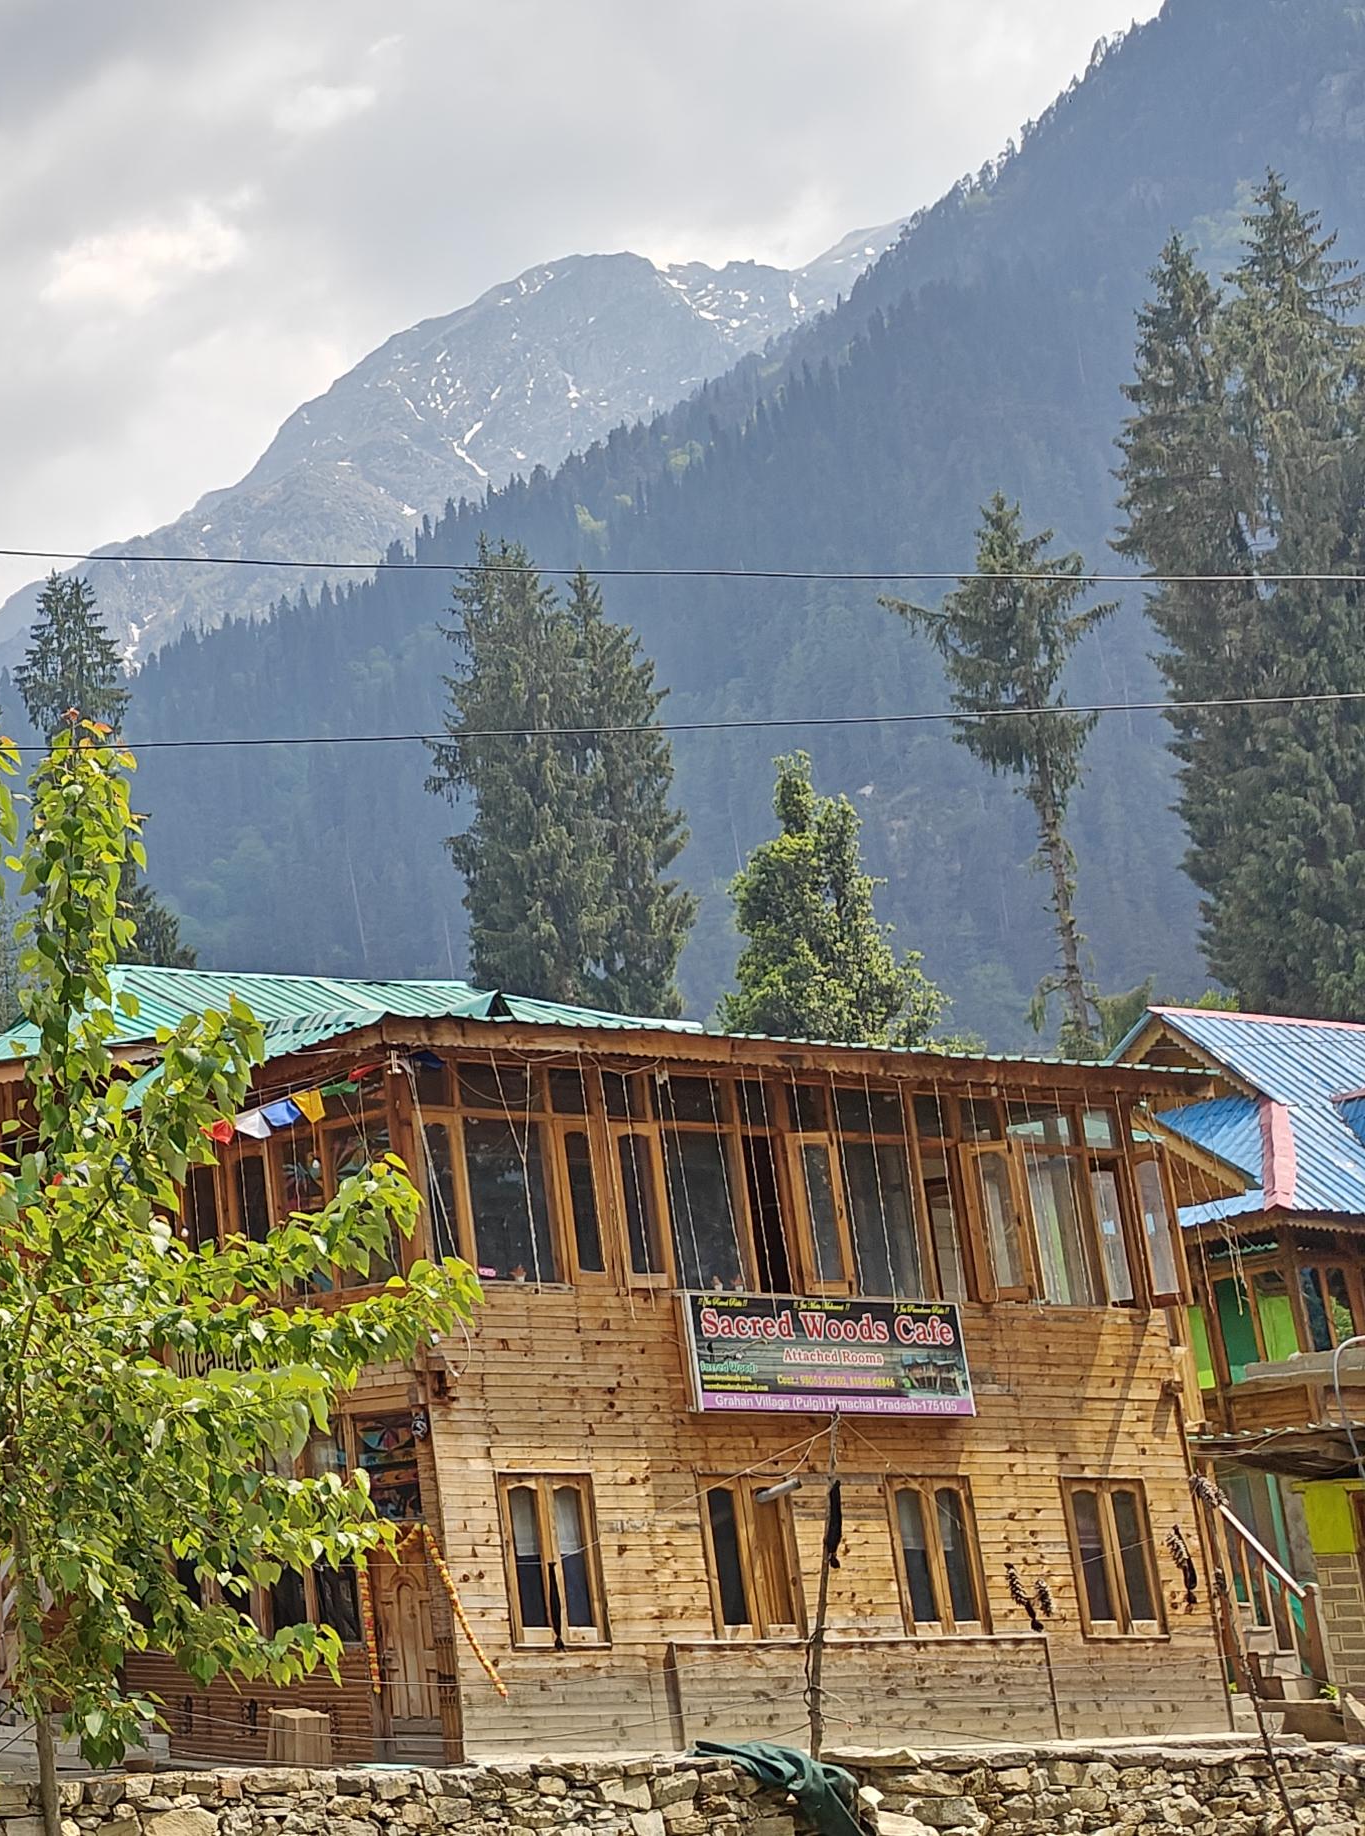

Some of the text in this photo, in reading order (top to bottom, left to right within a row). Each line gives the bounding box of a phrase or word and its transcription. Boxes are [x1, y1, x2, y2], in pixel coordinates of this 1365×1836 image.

[701, 1309, 954, 1345] Sacred Woods Cafe
[784, 1348, 884, 1366] Attached Rooms
[715, 1395, 753, 1407] Grahan
[756, 1396, 790, 1410] Village
